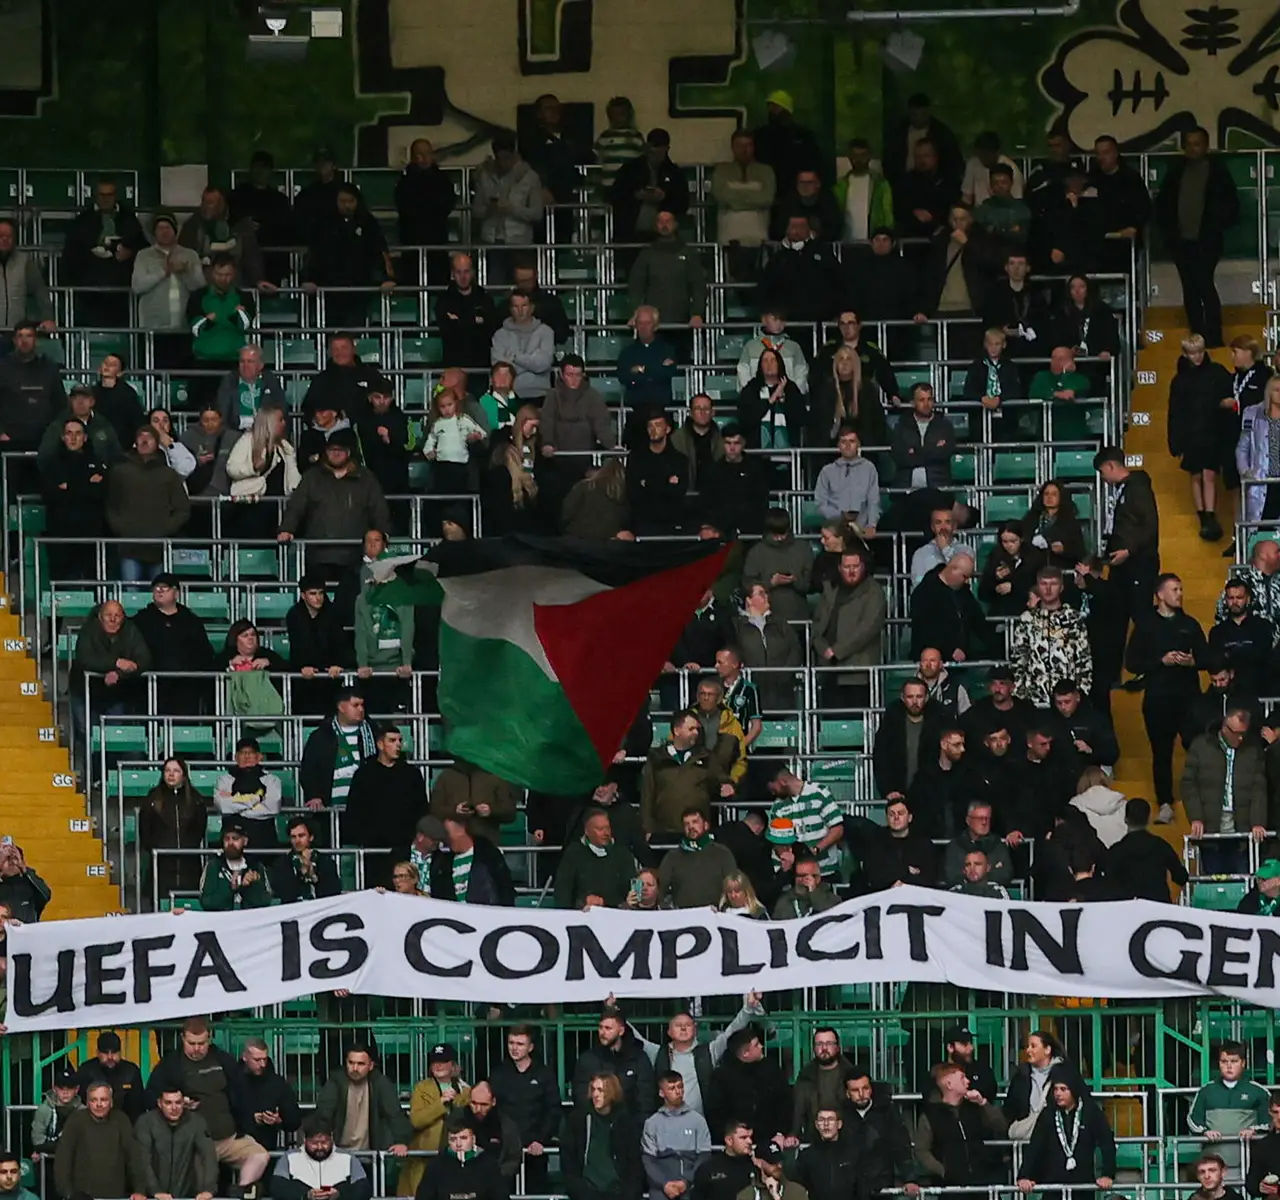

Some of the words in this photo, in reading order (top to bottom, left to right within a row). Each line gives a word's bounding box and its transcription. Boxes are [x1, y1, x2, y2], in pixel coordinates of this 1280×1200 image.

[10, 930, 248, 1019] UEFA
[280, 912, 369, 982] IS
[403, 904, 946, 982] COMPLICIT
[984, 907, 1085, 977] IN
